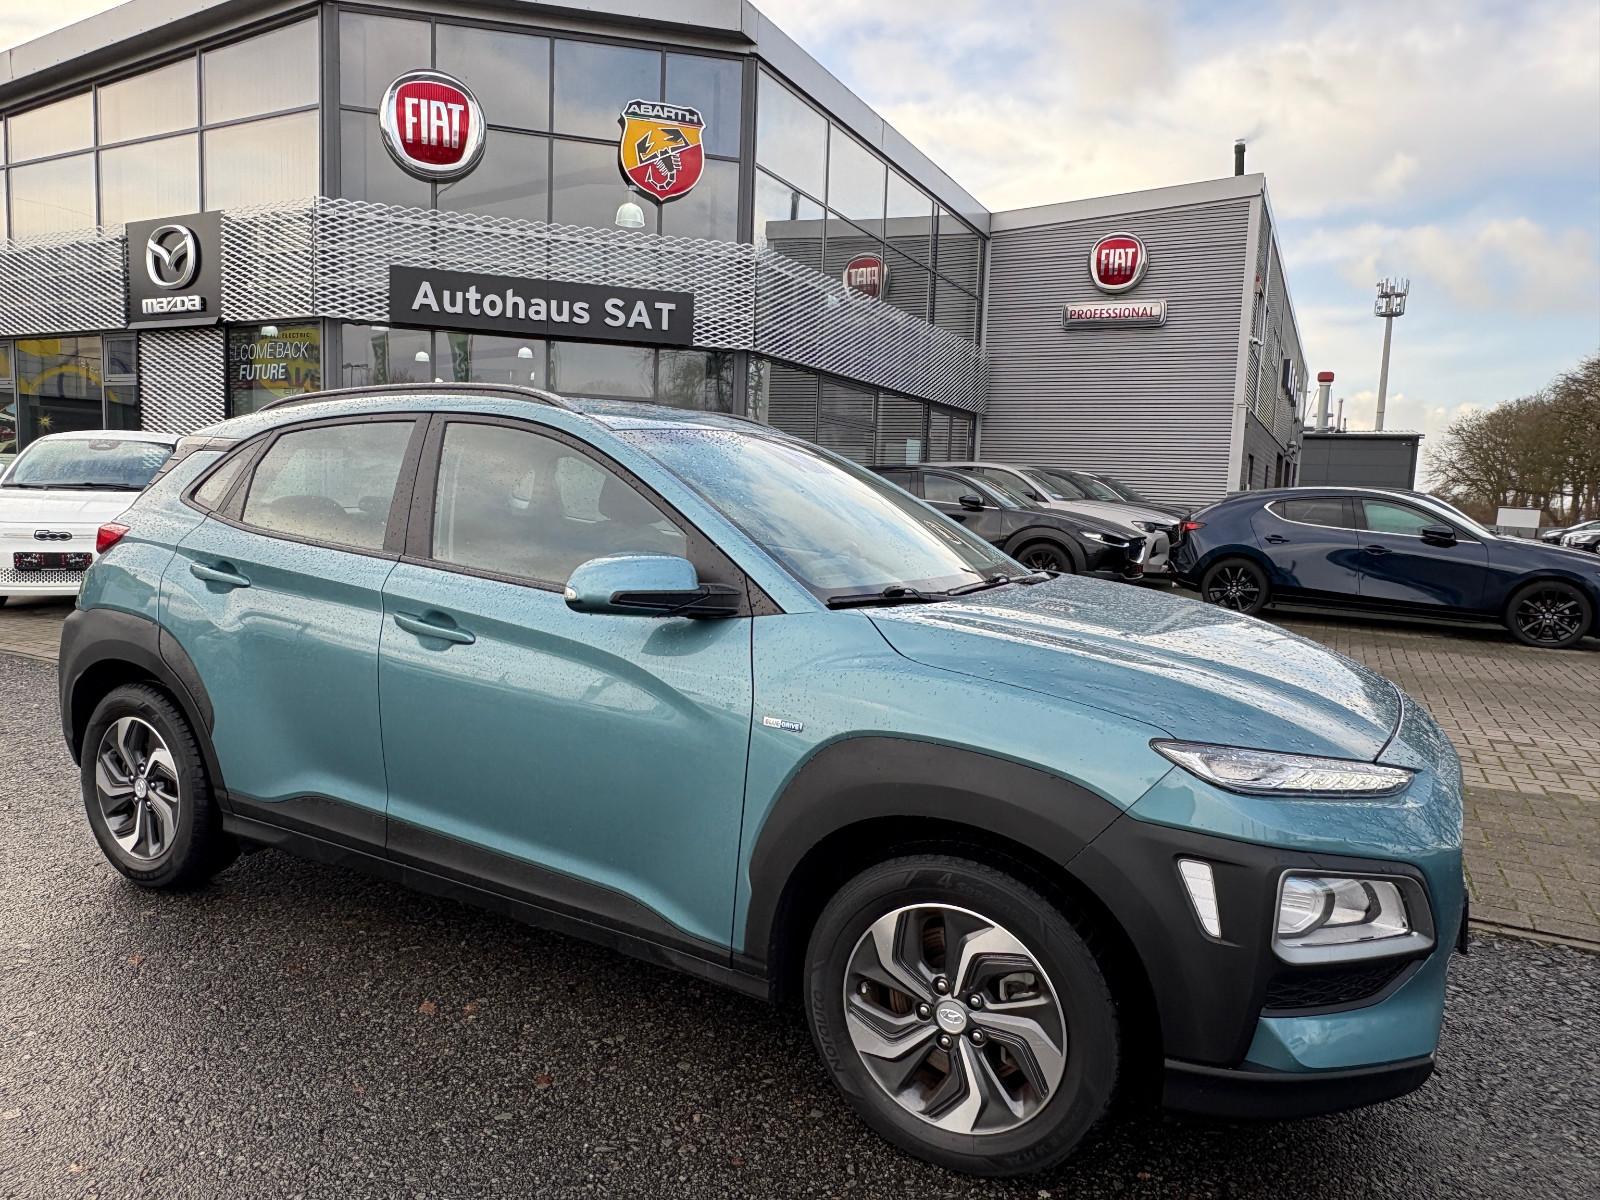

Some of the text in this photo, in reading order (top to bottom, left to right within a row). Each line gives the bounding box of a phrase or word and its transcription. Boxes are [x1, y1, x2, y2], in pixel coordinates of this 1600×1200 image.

[404, 96, 465, 149] FIAT
[627, 104, 698, 123] ABARTH
[1101, 247, 1135, 276] FIAT
[142, 295, 202, 314] mazda
[411, 280, 677, 331] Autohaus SAT
[1069, 306, 1156, 320] PROFESSIONAL
[276, 341, 310, 358] BACK
[239, 362, 287, 380] FUTURE
